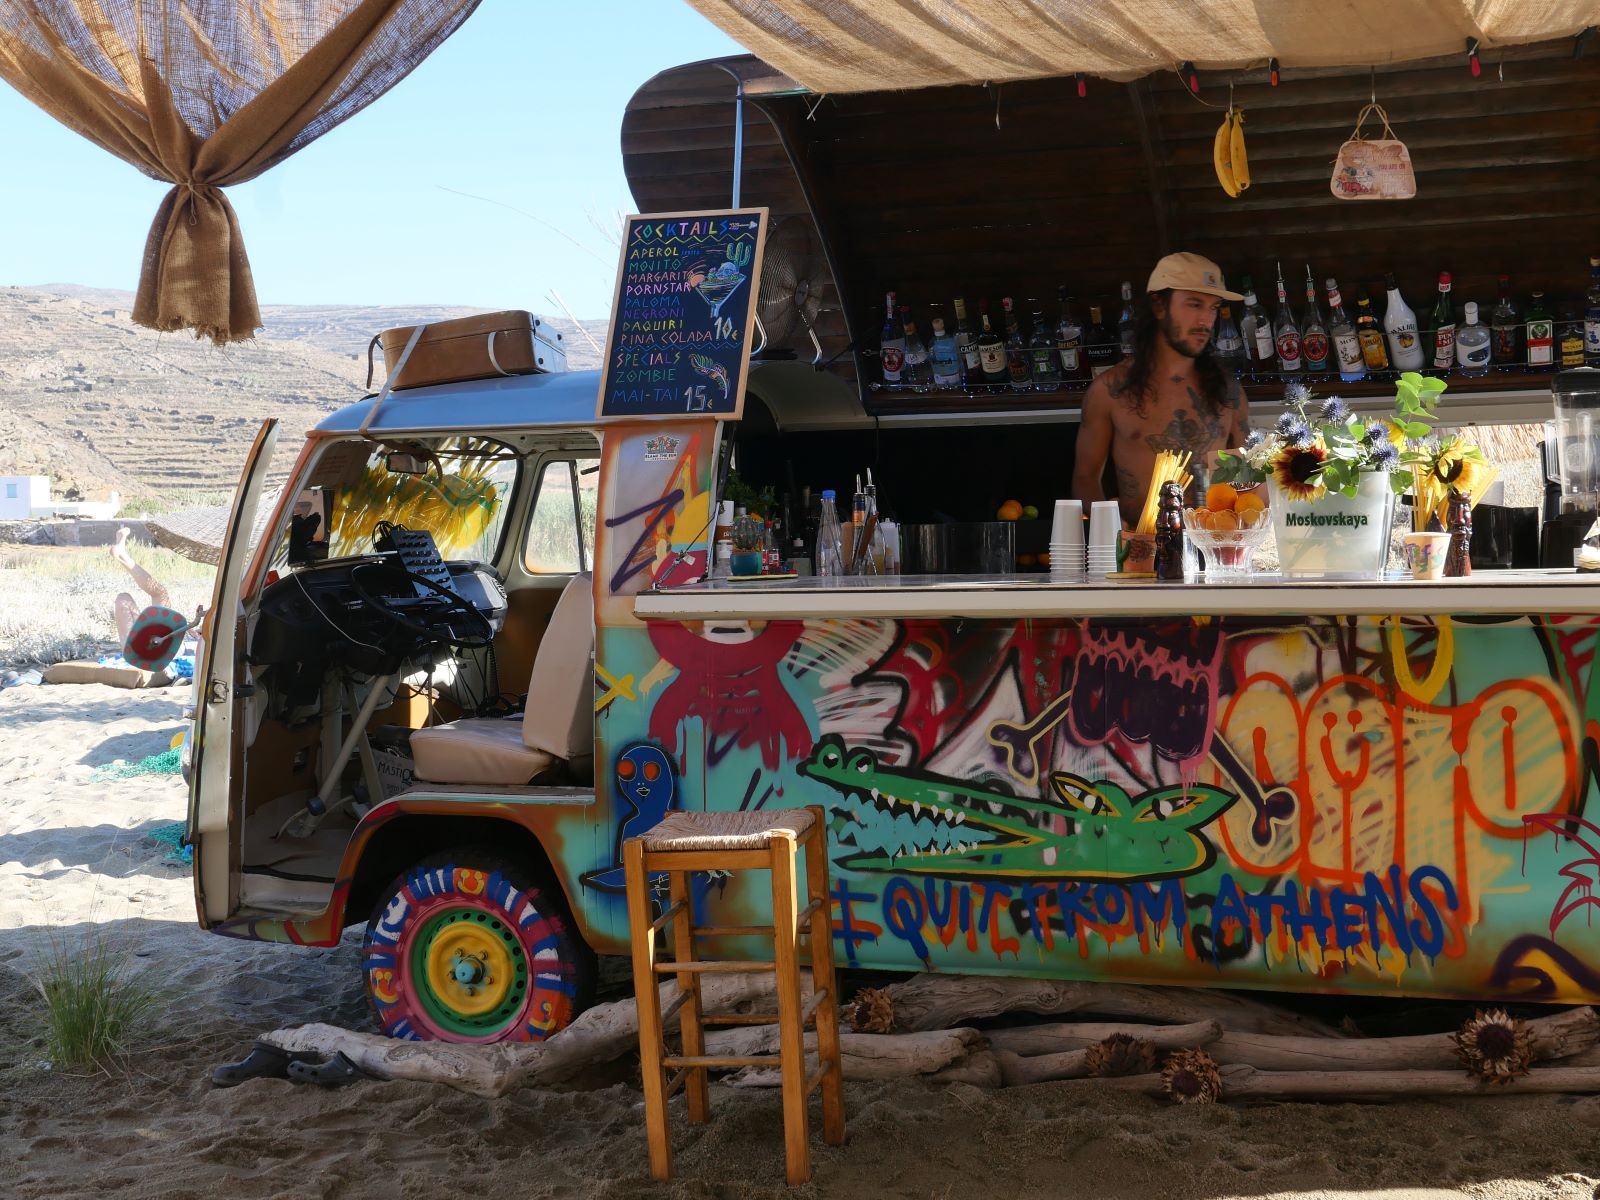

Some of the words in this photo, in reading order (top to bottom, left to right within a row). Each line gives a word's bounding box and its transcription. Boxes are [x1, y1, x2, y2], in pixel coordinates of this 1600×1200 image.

[634, 220, 728, 238] COCKTAILS
[630, 247, 679, 259] APEROL
[629, 259, 682, 272] MOJITO
[626, 282, 692, 296] PORNSTAR
[625, 296, 681, 308] PALOMA
[624, 309, 684, 319] NEGRONI
[623, 320, 683, 332] DAQUIRI
[620, 333, 655, 345] PINA
[661, 331, 713, 344] COLADA
[616, 351, 681, 368] SPECIALS
[616, 369, 677, 383] ZOMBIE
[612, 388, 679, 404] MAI-TAI
[1285, 511, 1368, 529] Moskovskaya
[1021, 880, 1188, 945] FROM
[1211, 862, 1460, 955] ATHENS
